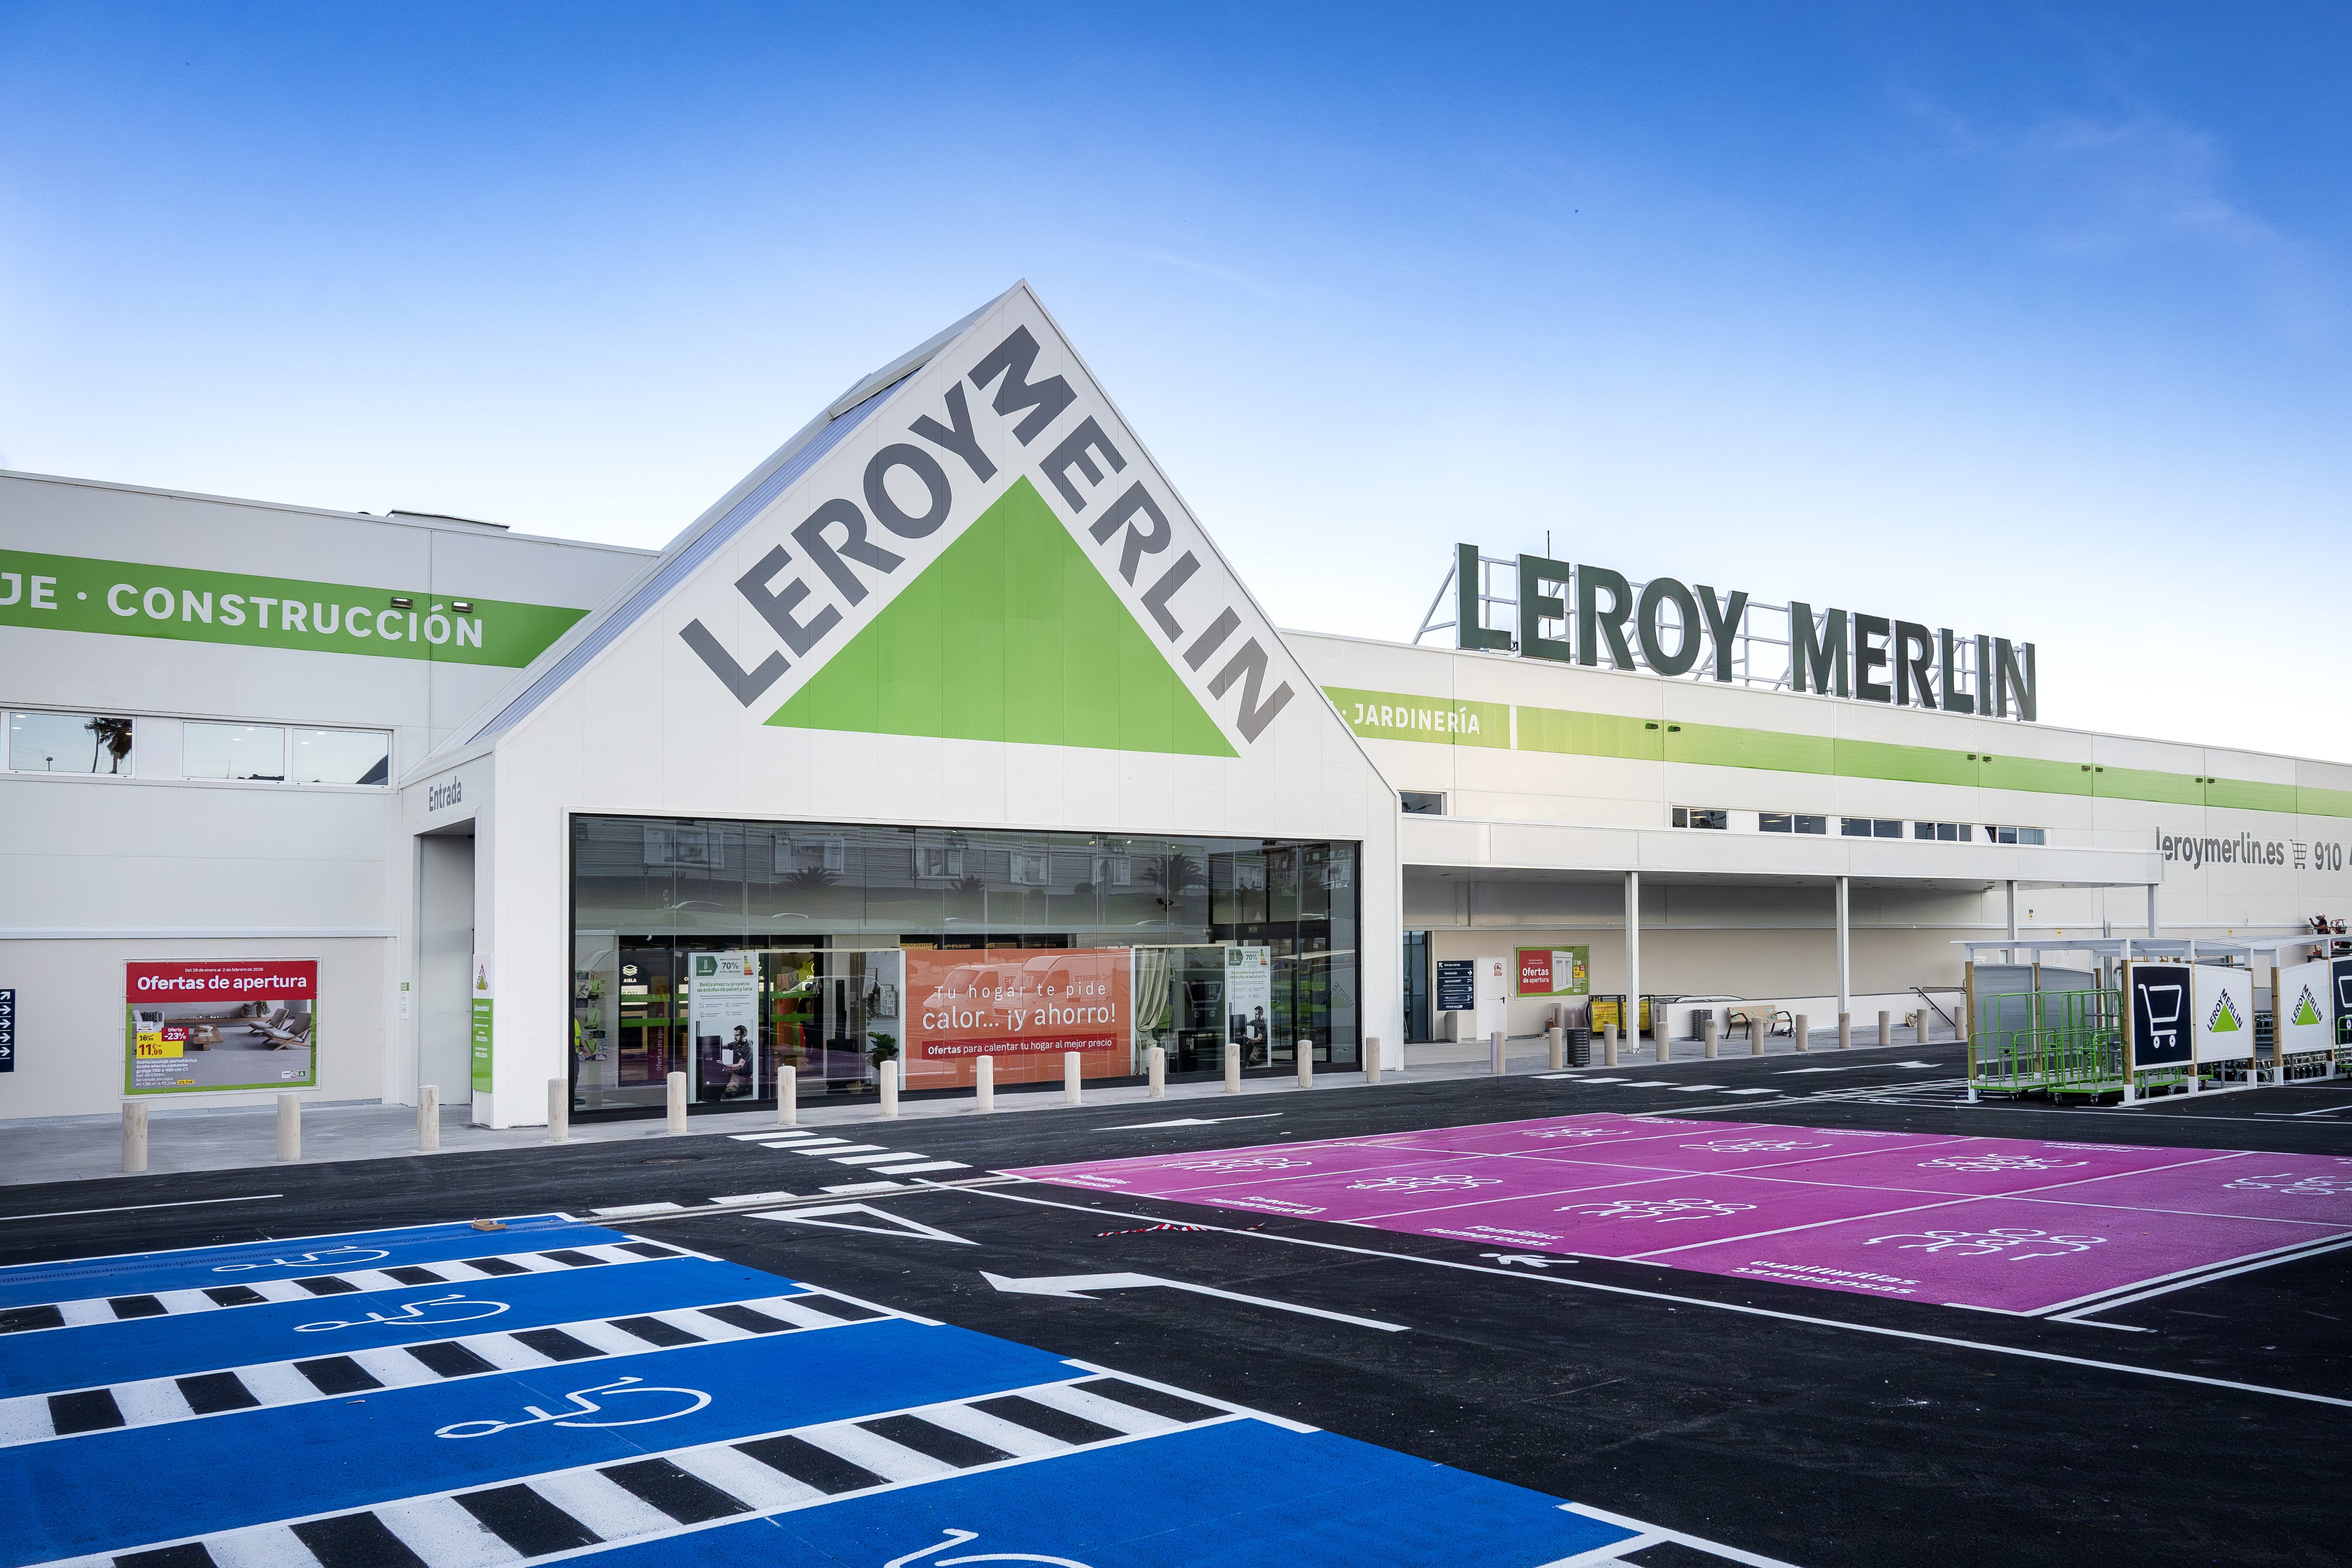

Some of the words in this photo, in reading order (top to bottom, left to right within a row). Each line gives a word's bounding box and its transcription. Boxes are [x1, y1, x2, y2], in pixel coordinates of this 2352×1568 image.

[679, 380, 998, 708] LEROY
[967, 324, 1295, 744] MERLIN
[108, 583, 483, 649] CONSTRUCCIÓN
[1455, 543, 1748, 682] LEROY
[1787, 601, 2036, 721] MERLIN
[1354, 703, 1481, 735] JARDINERÍA
[429, 776, 461, 812] Entrada
[2156, 826, 2284, 870] leroymerlin.es
[2314, 841, 2341, 871] 910
[138, 976, 204, 990] Ofertas
[208, 976, 230, 989] de
[233, 975, 306, 991] apertura
[1522, 967, 1549, 976] Ofertas
[935, 985, 956, 999] Tu
[969, 984, 1026, 1001] hogar
[1037, 984, 1055, 997] te
[1066, 981, 1106, 998] pide
[2221, 988, 2243, 1029] MERLIN
[2291, 991, 2306, 1025] LEROY
[2303, 984, 2323, 1022] MERLIN
[923, 1006, 999, 1030] calor...
[1007, 1009, 1027, 1031] ¡y
[1034, 1003, 1115, 1025] ahorro!
[2207, 996, 2224, 1031] LEROY
[928, 1046, 961, 1055] Ofertas
[963, 1046, 982, 1054] para
[984, 1043, 1019, 1052] calentar
[1021, 1042, 1029, 1050] tu
[1030, 1040, 1053, 1051] hogar
[1065, 1039, 1087, 1049] mejor
[1088, 1038, 1112, 1048] precio
[1464, 1225, 1565, 1240] Familias
